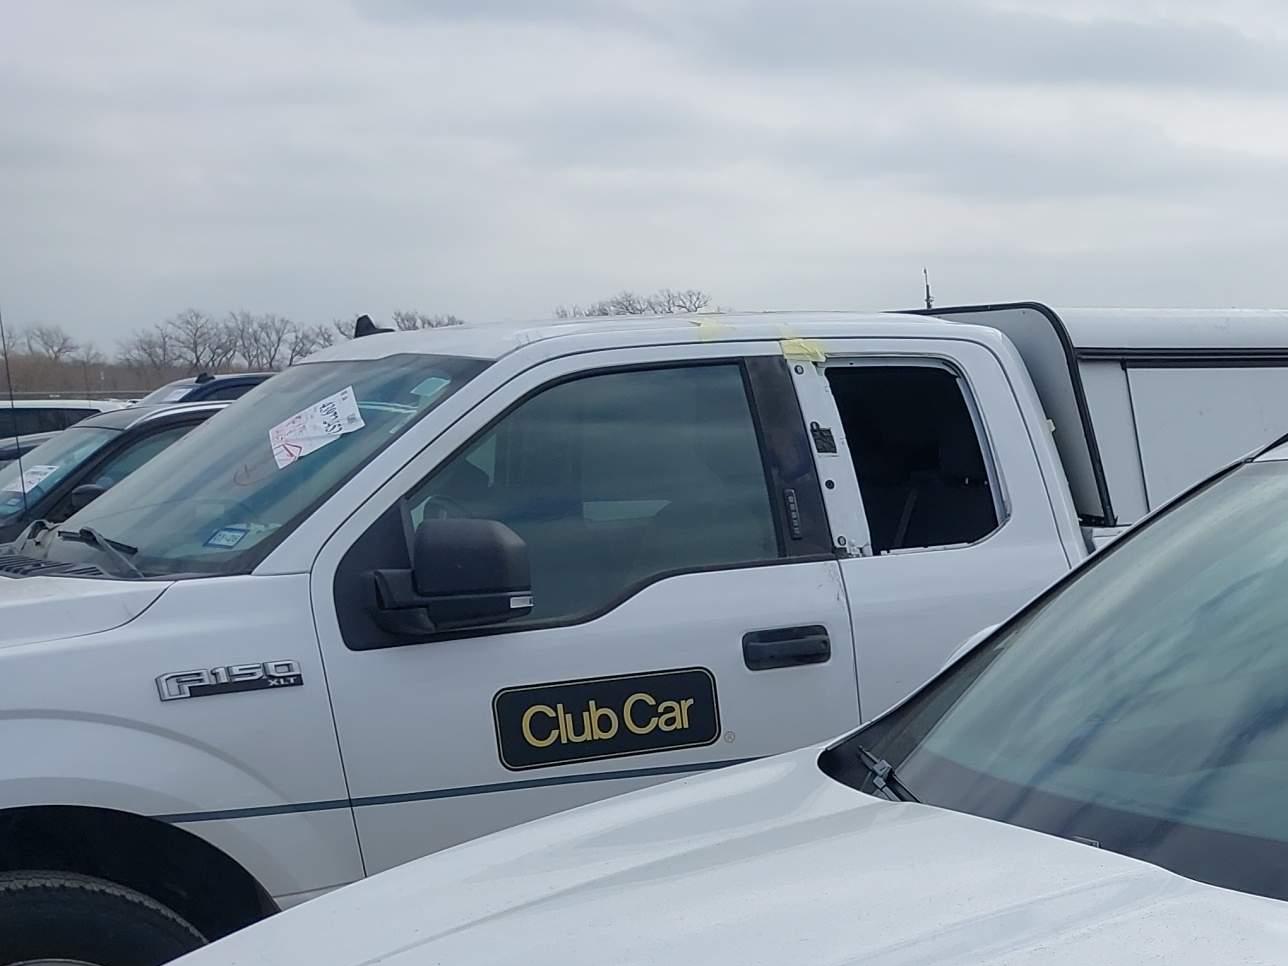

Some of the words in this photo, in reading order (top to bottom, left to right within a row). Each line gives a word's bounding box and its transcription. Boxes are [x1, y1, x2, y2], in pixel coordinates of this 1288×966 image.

[268, 677, 296, 687] XLT
[521, 700, 619, 748] Club
[623, 692, 695, 735] Car
